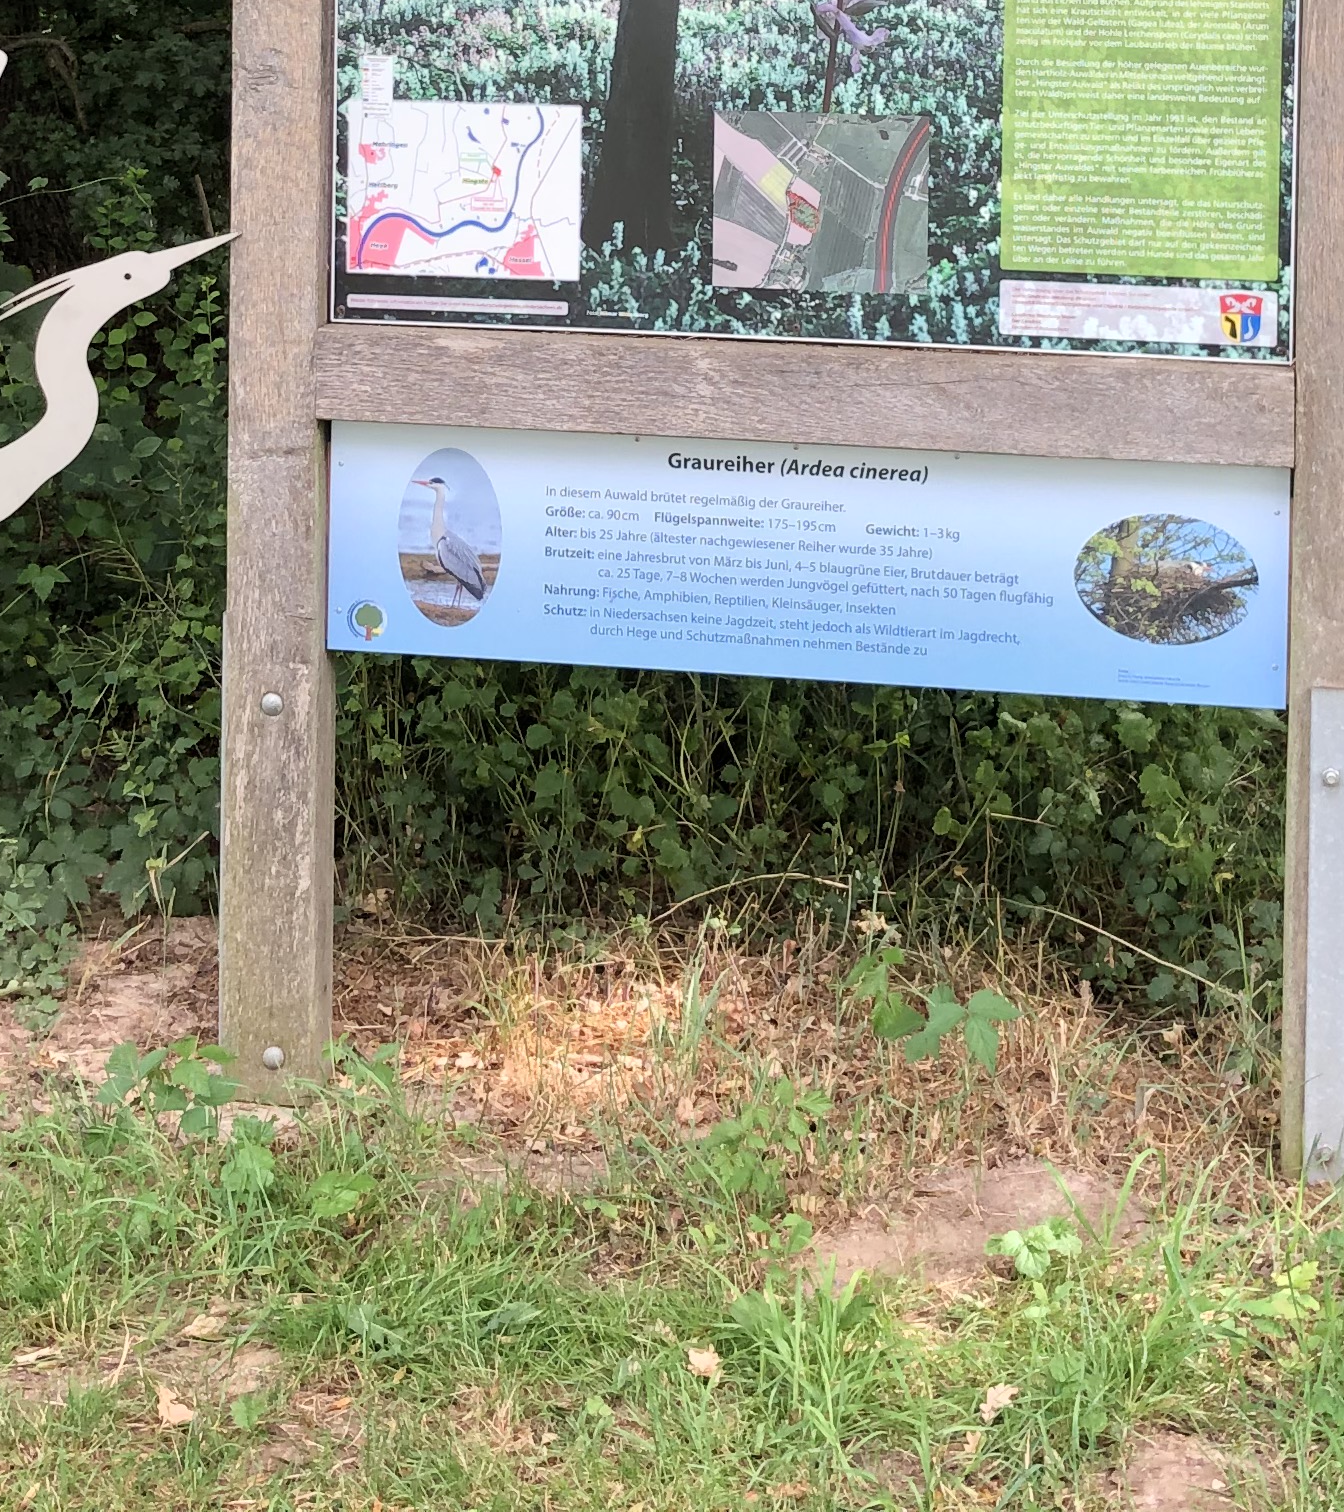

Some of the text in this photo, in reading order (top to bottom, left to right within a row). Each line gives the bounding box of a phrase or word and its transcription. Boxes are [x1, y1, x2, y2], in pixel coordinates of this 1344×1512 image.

[667, 451, 929, 485] Graureiher (Ardea cinerea)
[545, 484, 847, 513] In diesem Auwald brütet regelmäßig der Graureiher.
[544, 504, 586, 519] Größe:
[587, 509, 604, 520] ca.
[653, 510, 765, 529] Flügelspannweite:
[864, 522, 920, 538] Gewicht:
[543, 524, 933, 560] Alter: bis 25 Jahre (ältester nachgewiesener Reiher wurde 35 Jahre)
[543, 545, 595, 560] Brutzeit:
[596, 548, 622, 561] eine
[623, 549, 686, 565] Jahresbrut
[687, 555, 711, 566] von
[713, 554, 743, 568] März
[744, 556, 762, 570] bis
[763, 557, 792, 573] Juni,
[818, 560, 881, 578] blaugrüne
[882, 564, 908, 580] Eier,
[910, 566, 972, 582] Brutdauer
[973, 569, 1019, 588] beträgt
[543, 582, 896, 616] Nahrung: Fische, Amphibien, Reptilien, Kleinsäuger, Insekten
[597, 567, 614, 578] ca.
[615, 567, 630, 579] 25
[631, 567, 663, 583] Tage,
[688, 571, 737, 586] Wochen
[739, 574, 784, 588] werden
[785, 576, 849, 594] Jungvögel
[850, 580, 908, 597] gefüttert,
[910, 584, 940, 598] nach
[942, 586, 958, 599] 50
[959, 587, 996, 603] Tagen
[998, 589, 1054, 607] flugfähig
[543, 602, 1021, 646] Schutz: in Niedersachsen keine Jagdzeit, steht jedoch als Wildtierart im Jagdrecht,
[589, 622, 927, 656] durch Hege und Schutzmaßnahmen nehmen Bestände zu
